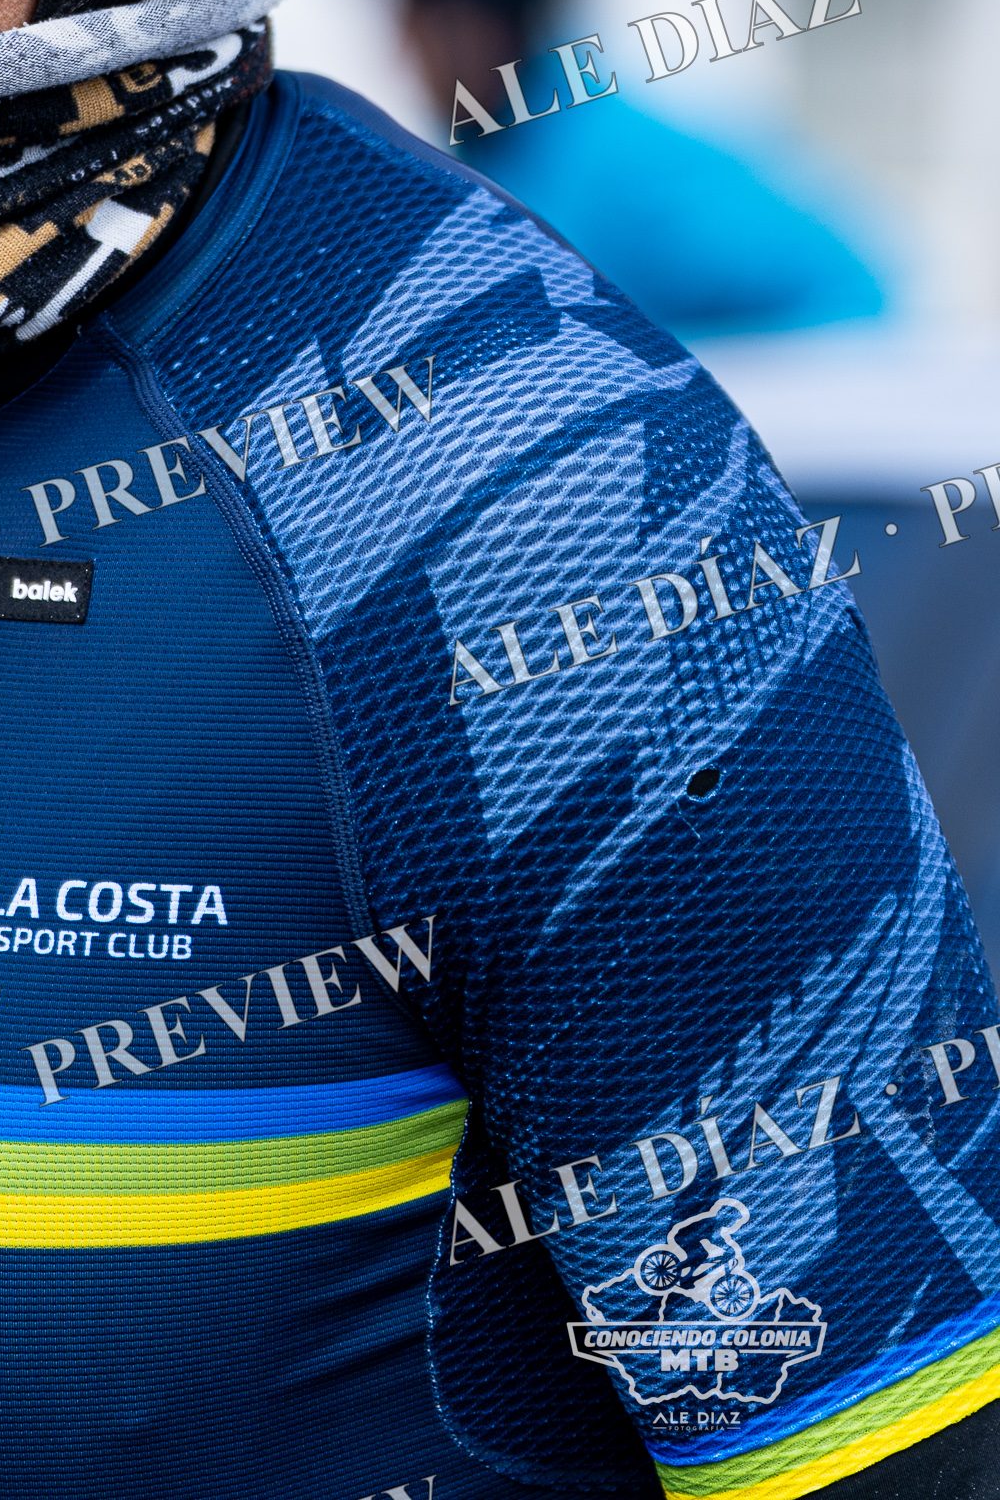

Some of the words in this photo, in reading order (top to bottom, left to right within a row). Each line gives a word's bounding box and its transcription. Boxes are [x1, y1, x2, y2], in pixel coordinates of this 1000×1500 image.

[12, 578, 77, 602] balek
[55, 880, 228, 925] COSTA
[108, 933, 193, 959] CLUB
